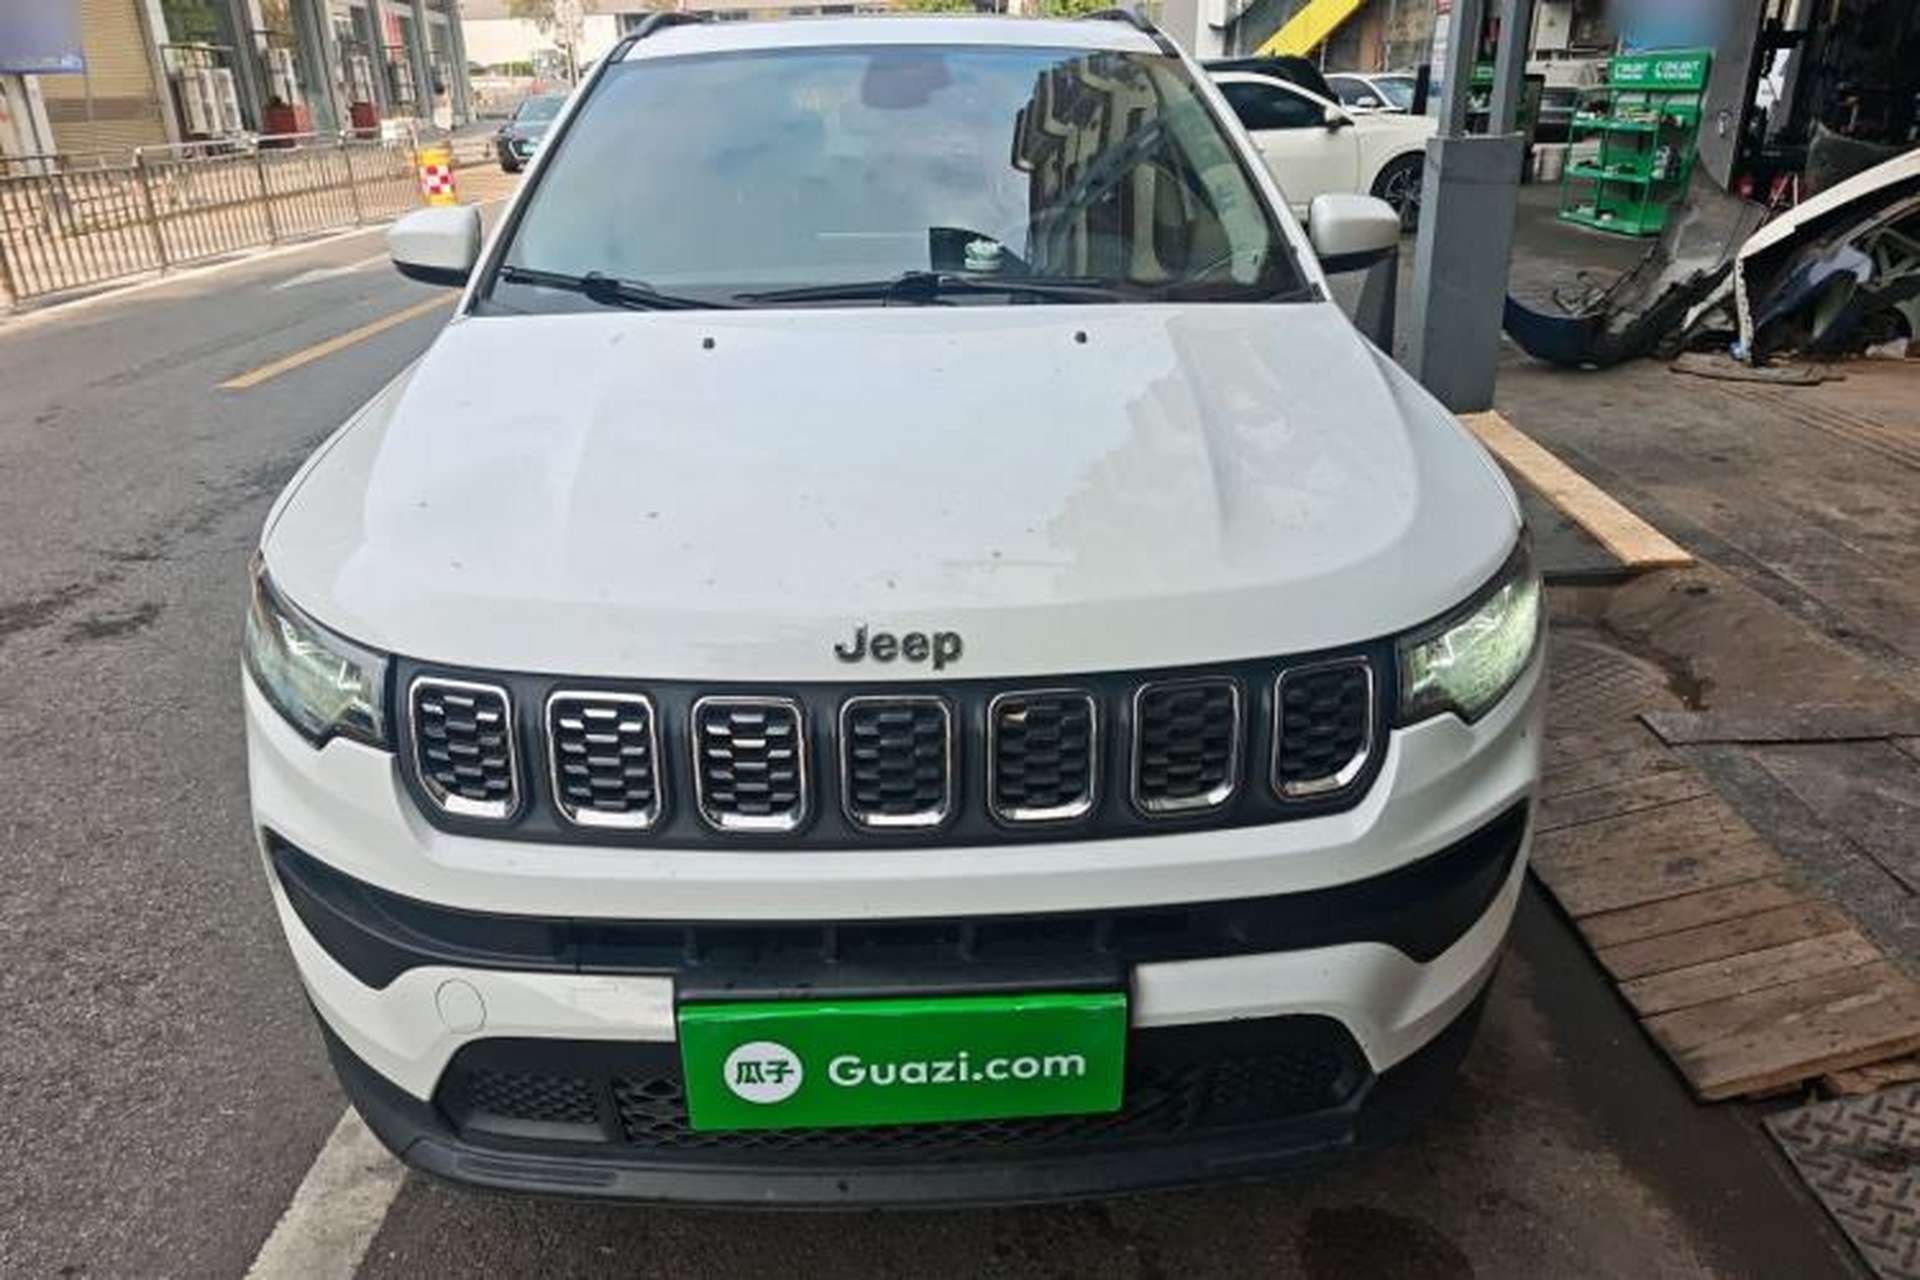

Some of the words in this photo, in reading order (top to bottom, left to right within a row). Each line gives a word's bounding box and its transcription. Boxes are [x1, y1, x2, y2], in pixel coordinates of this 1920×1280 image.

[834, 623, 964, 670] Jeep
[735, 1060, 795, 1085] 瓜子
[828, 1051, 1086, 1087] Guazi.com
